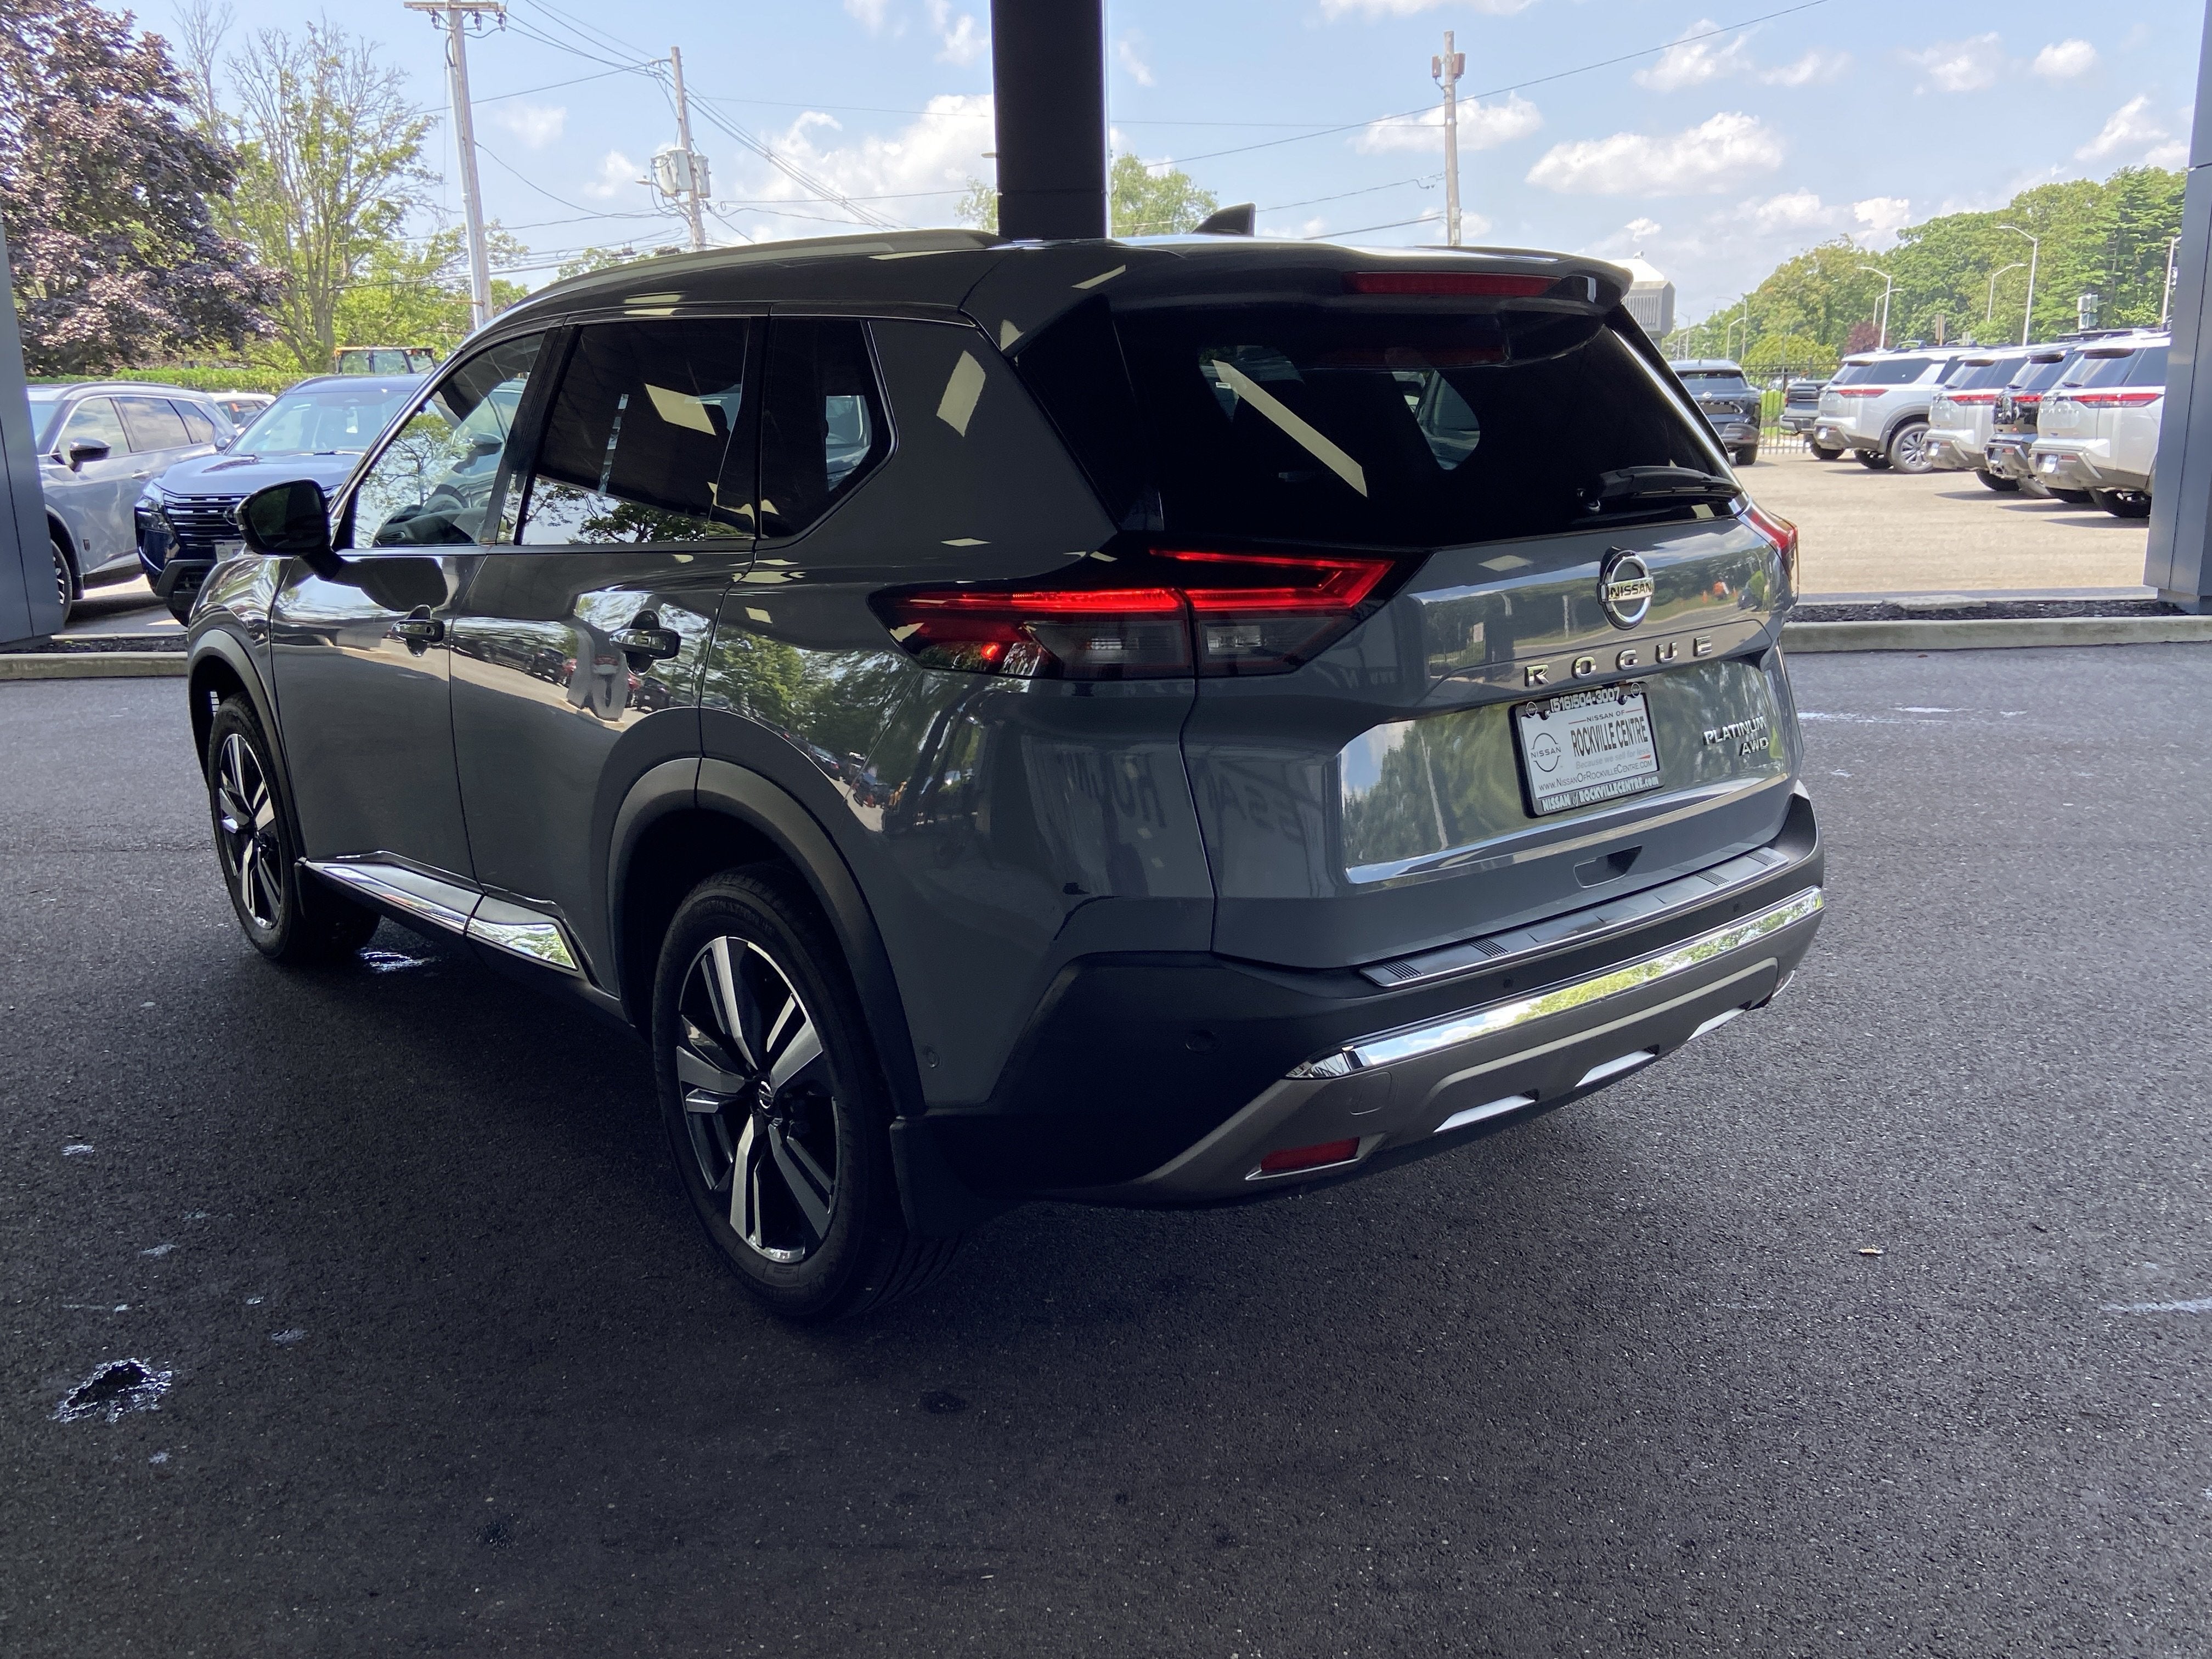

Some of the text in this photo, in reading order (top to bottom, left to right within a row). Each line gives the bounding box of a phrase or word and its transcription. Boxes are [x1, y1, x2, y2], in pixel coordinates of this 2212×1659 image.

[1610, 583, 1652, 597] NISSAN
[1525, 635, 1712, 686] ROGUE
[1549, 686, 1620, 712] (516)504-3007
[1586, 712, 1613, 723] NISSAN
[1570, 716, 1649, 757] ROCKVILLE CENTRE
[1703, 716, 1767, 745] PLATINUM
[1530, 747, 1561, 759] NISSAN
[1739, 737, 1769, 756] AWD
[1576, 757, 1603, 769] Because
[1615, 752, 1626, 761] sell
[1627, 750, 1636, 758] for
[1542, 776, 1659, 812] NISSAN of ROCKVILLECENTRE.com
